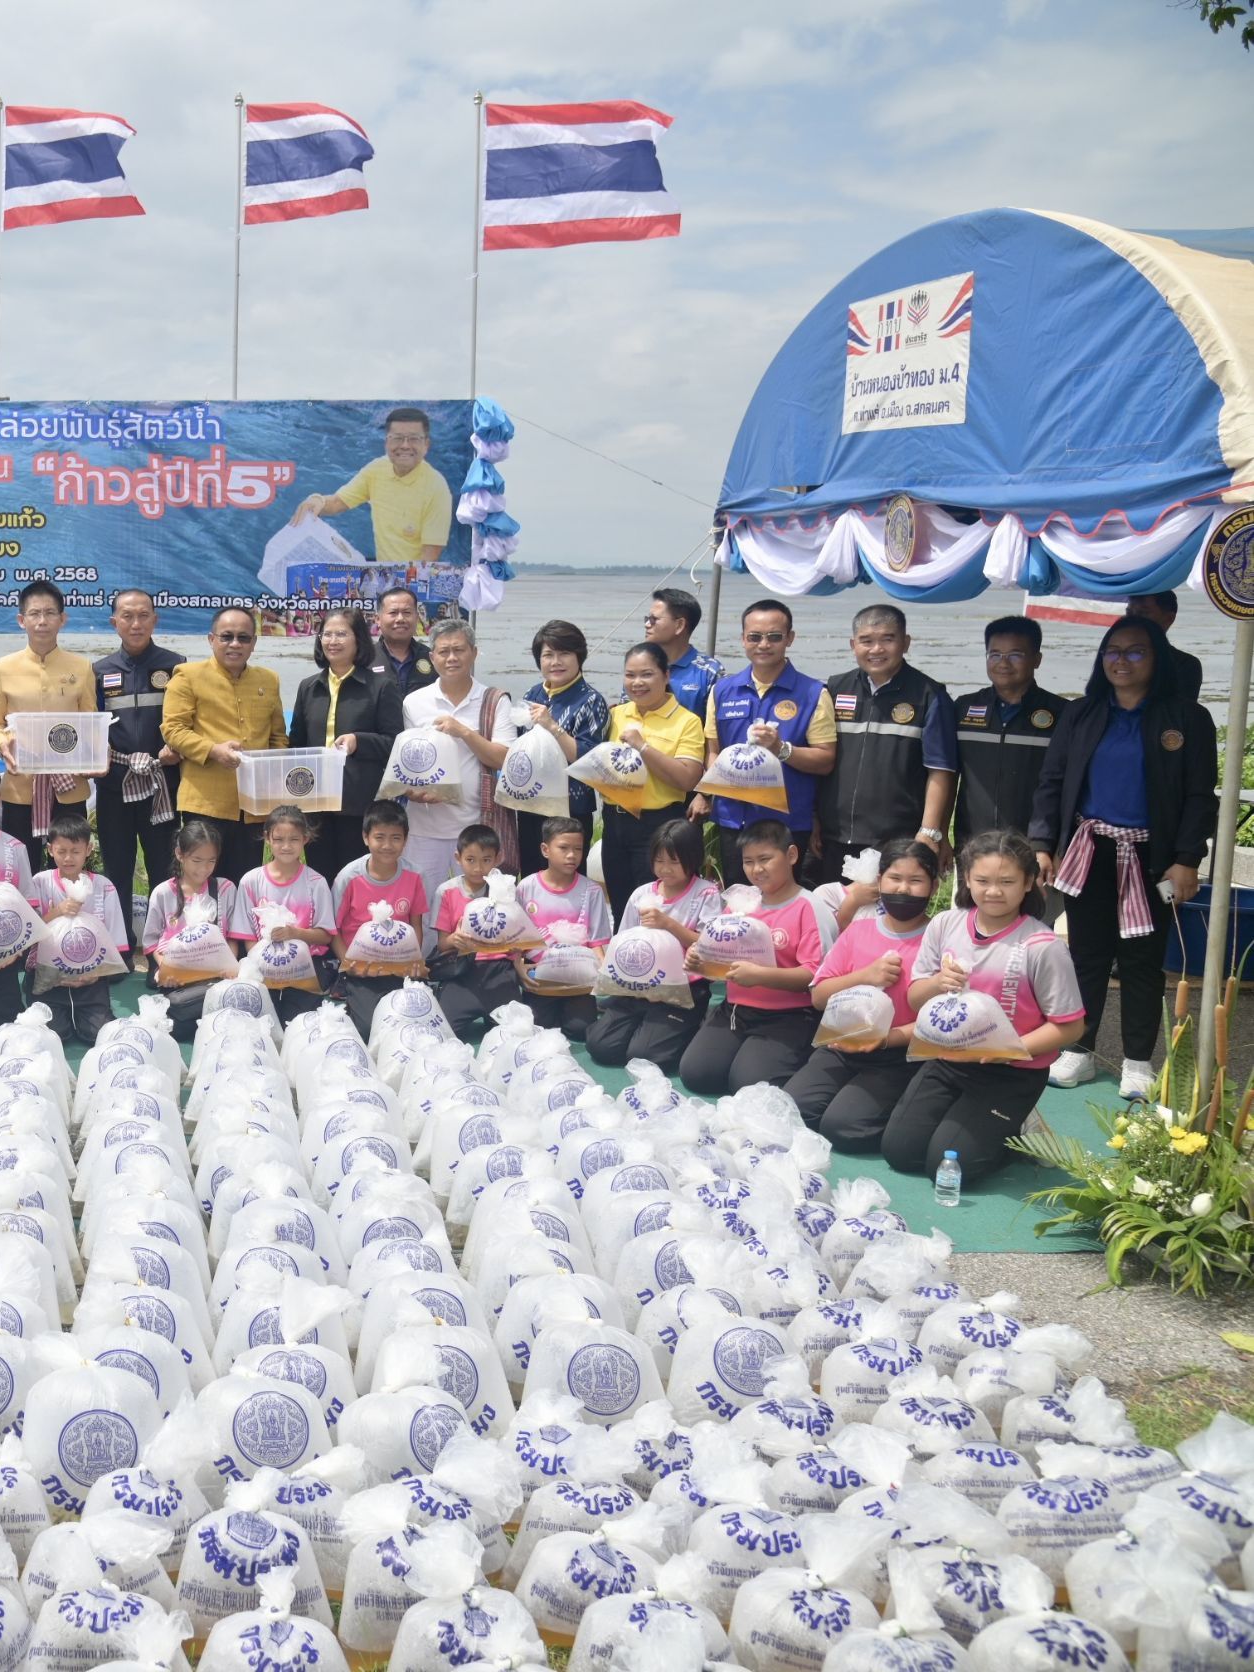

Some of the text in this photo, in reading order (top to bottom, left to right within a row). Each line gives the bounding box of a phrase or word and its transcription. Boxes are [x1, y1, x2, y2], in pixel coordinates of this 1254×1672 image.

[851, 362, 960, 398] บ้านหนองบัวทอง ม.4
[54, 565, 98, 582] 2568
[392, 763, 446, 788] กรมประมง
[501, 774, 544, 801] กรมประมง
[51, 947, 107, 977] กรมประมง
[607, 963, 666, 991] กรมประมง
[958, 1314, 1021, 1349] กรมประม
[796, 1452, 868, 1490] กรมปร
[275, 1479, 333, 1505] ประม
[401, 1478, 473, 1521] กรมประ
[1022, 1475, 1109, 1514] กรมประม
[1177, 1486, 1254, 1529] กรมป
[720, 1511, 803, 1557] กรมประ
[28, 1644, 125, 1660] ศูนย์วิจัยและพัฒนาประ
